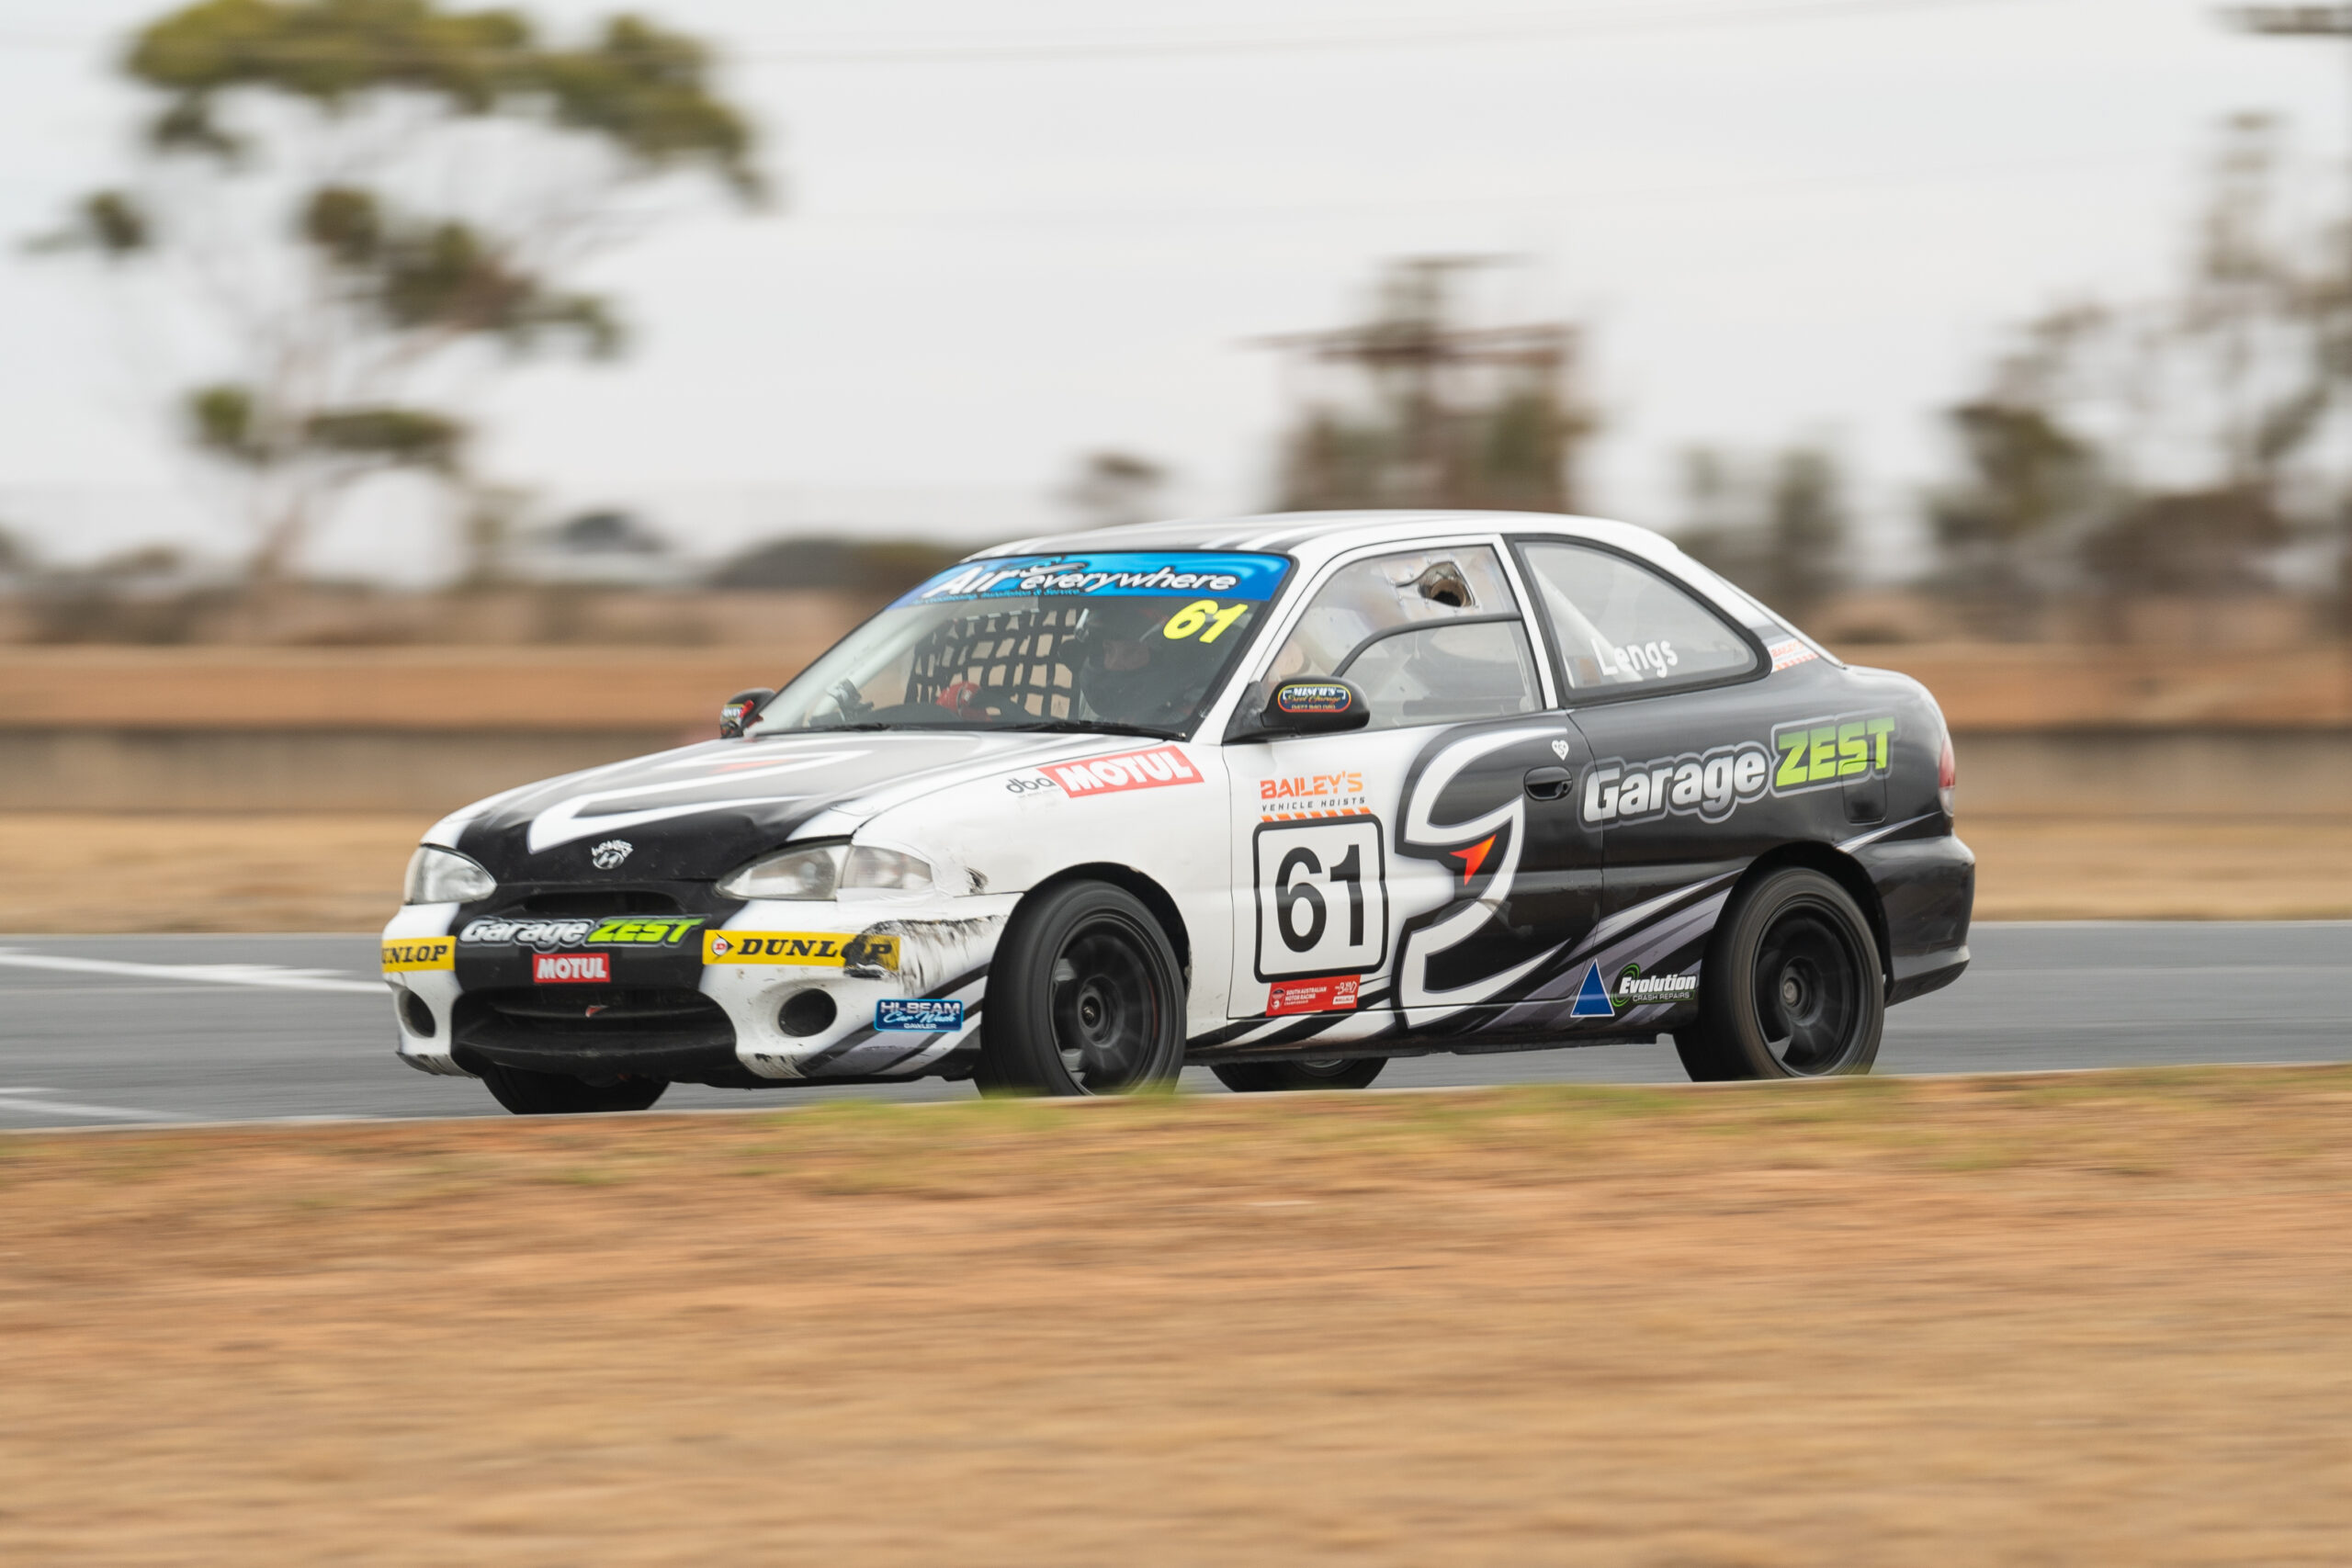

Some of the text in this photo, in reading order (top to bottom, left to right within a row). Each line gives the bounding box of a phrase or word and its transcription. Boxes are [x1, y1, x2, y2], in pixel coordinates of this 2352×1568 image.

[921, 566, 1022, 598] Air
[1020, 566, 1237, 592] everywhere
[1162, 600, 1248, 643] 61
[1591, 637, 1679, 678] Lengs
[1055, 750, 1194, 793] MOTUL
[1582, 716, 1895, 822] Garage ZEST
[1006, 776, 1056, 794] dba
[1260, 770, 1363, 800] BAILEY'S
[1261, 796, 1365, 812] VEHICLE HOISTS
[1275, 843, 1364, 953] 61
[460, 919, 705, 947] Garage ZEST
[537, 957, 607, 980] MOTUL
[1618, 974, 1697, 995] Evolution
[1633, 991, 1690, 1002] CRASH REPAIRS
[880, 1001, 961, 1015] HI-BEAM
[883, 1010, 956, 1023] Car Wash
